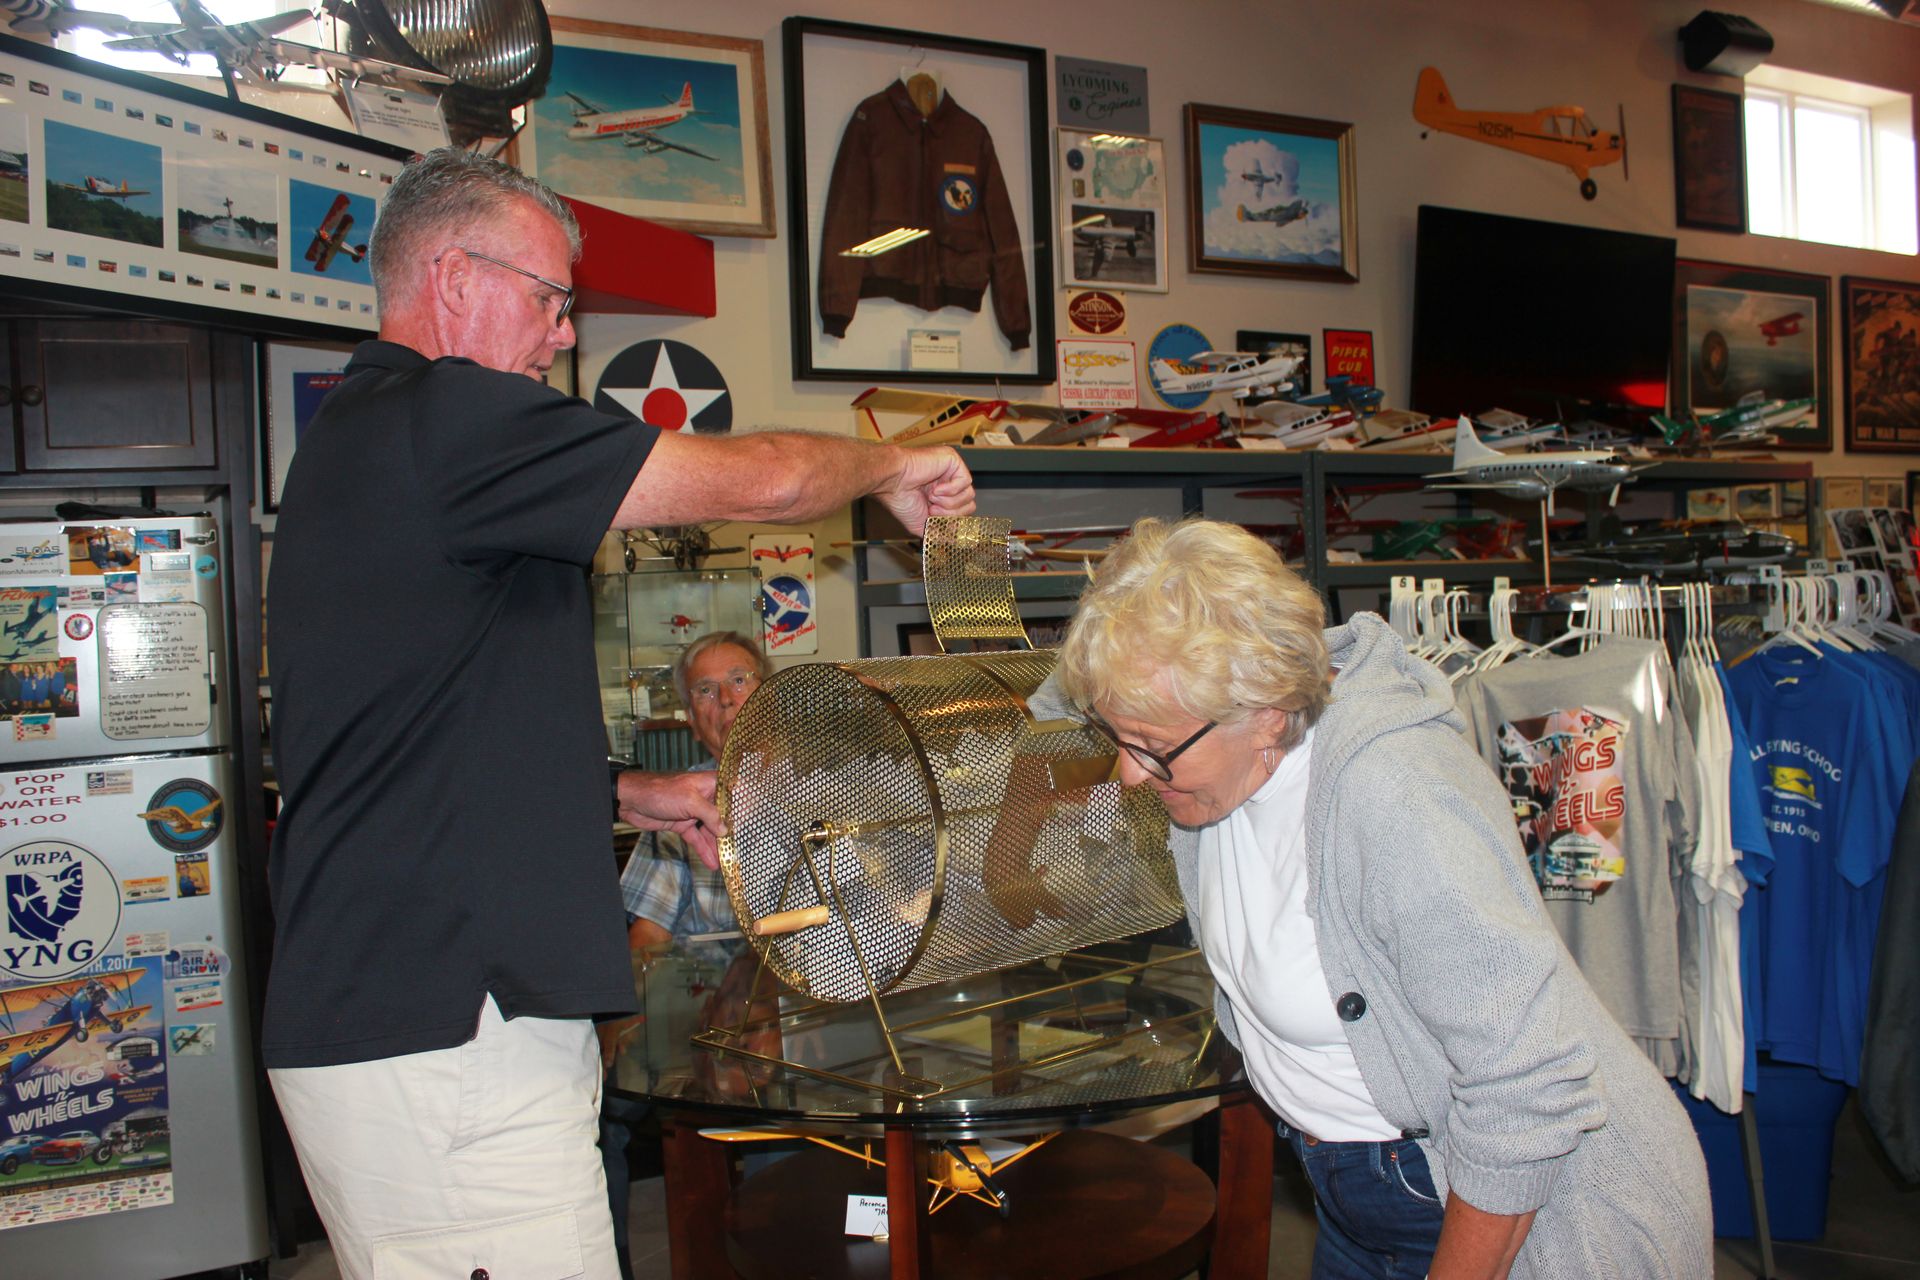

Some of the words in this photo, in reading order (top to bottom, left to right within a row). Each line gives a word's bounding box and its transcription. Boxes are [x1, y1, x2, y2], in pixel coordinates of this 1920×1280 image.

[1062, 72, 1129, 95] LYCOMING
[1086, 91, 1142, 120] Engines
[1332, 346, 1369, 358] PIPER
[1338, 361, 1362, 372] CUB
[1399, 577, 1407, 588] S
[772, 591, 788, 603] KEEP
[1749, 744, 1768, 761] LL
[1533, 735, 1617, 794] WNGS
[15, 773, 65, 785] POP
[20, 785, 56, 796] OR
[0, 795, 82, 810] WATER
[0, 813, 67, 828] $1.00
[1533, 785, 1625, 848] WEELS
[14, 850, 73, 867] WRPA
[4, 940, 94, 969] YNG
[182, 956, 204, 966] AIR
[107, 957, 133, 971] 2017
[24, 1033, 51, 1047] US
[15, 1061, 105, 1102] WINGS
[8, 1088, 114, 1134] WHEELS
[860, 1198, 886, 1208] Aeronca
